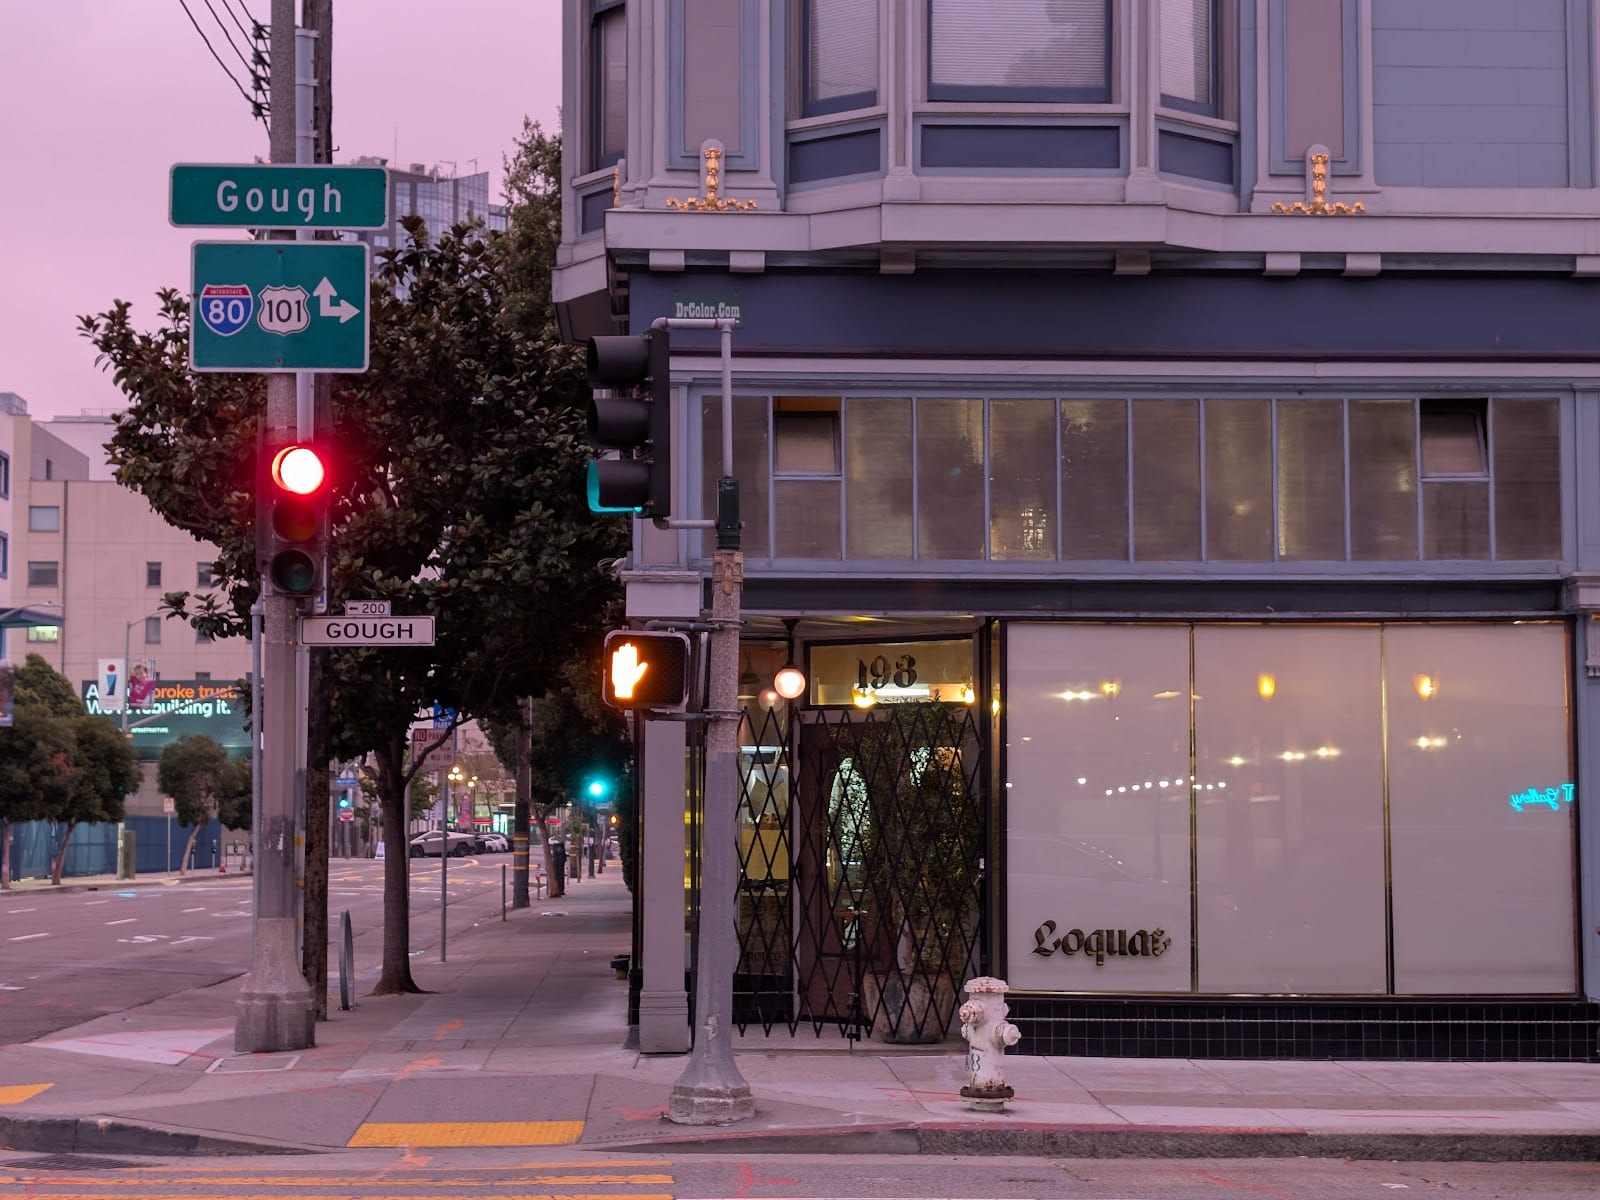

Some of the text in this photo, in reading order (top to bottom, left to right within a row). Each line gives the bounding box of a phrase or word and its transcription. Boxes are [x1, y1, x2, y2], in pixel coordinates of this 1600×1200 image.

[216, 180, 342, 222] Gough
[208, 299, 245, 324] 80
[266, 299, 302, 323] 101
[675, 302, 741, 318] DrColor.Com
[361, 603, 386, 614] 200
[326, 623, 413, 639] GOUGH
[857, 654, 918, 689] 198
